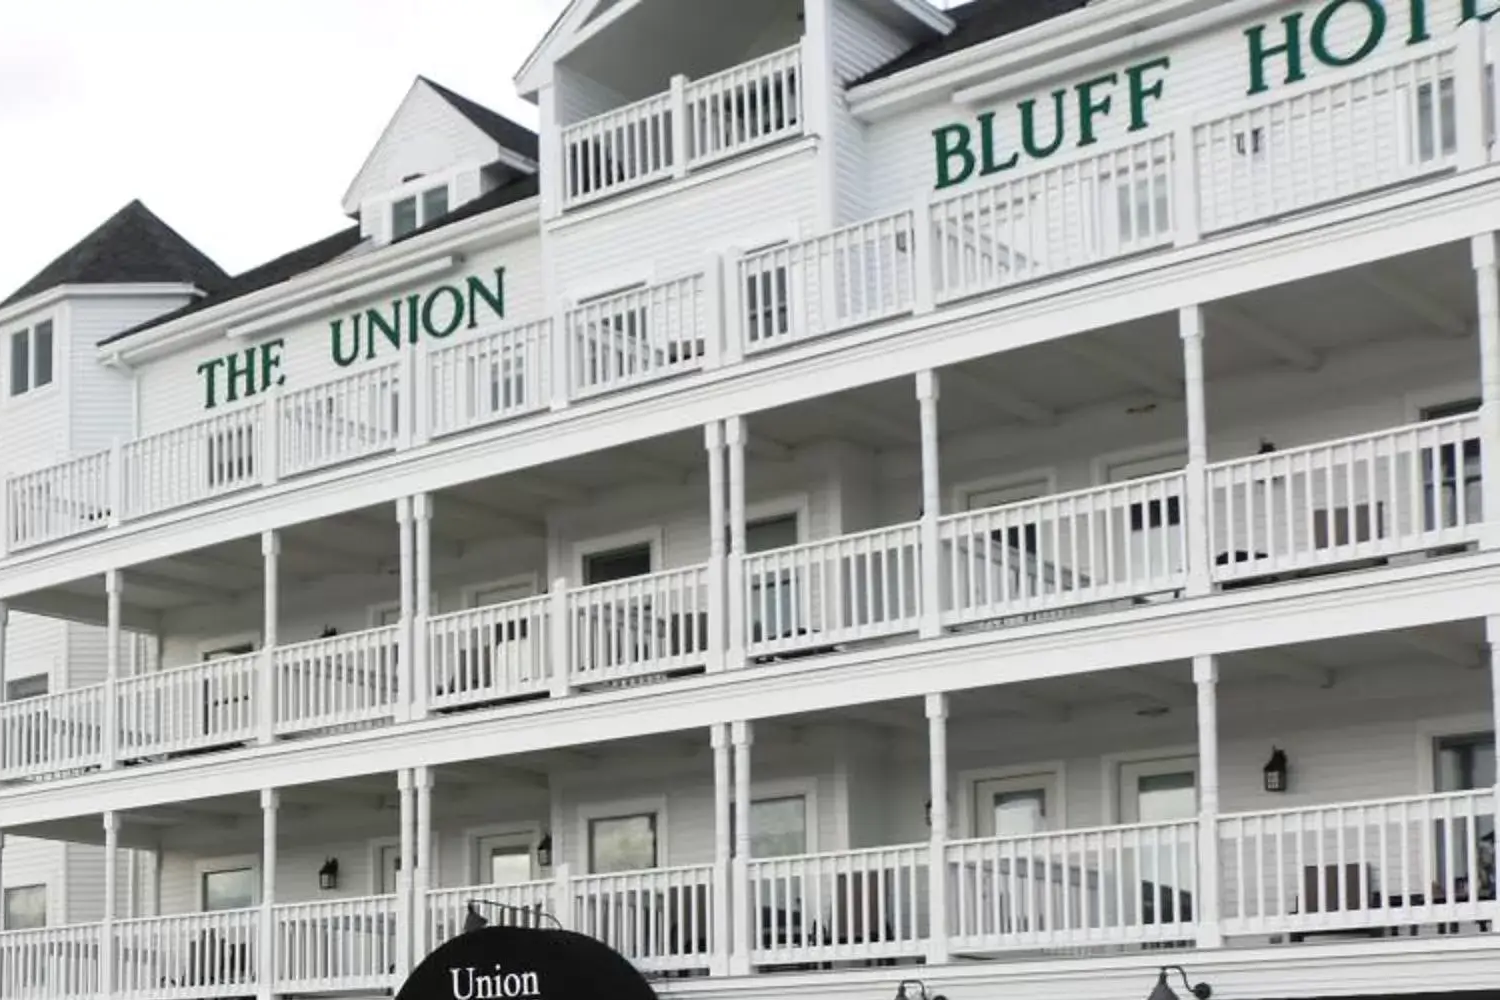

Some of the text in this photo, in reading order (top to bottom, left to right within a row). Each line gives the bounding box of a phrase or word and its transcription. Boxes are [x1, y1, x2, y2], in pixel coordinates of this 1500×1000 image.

[197, 338, 285, 408] THE
[329, 266, 505, 366] UNION
[931, 56, 1171, 190] BLUFF
[451, 964, 540, 1000] Union
